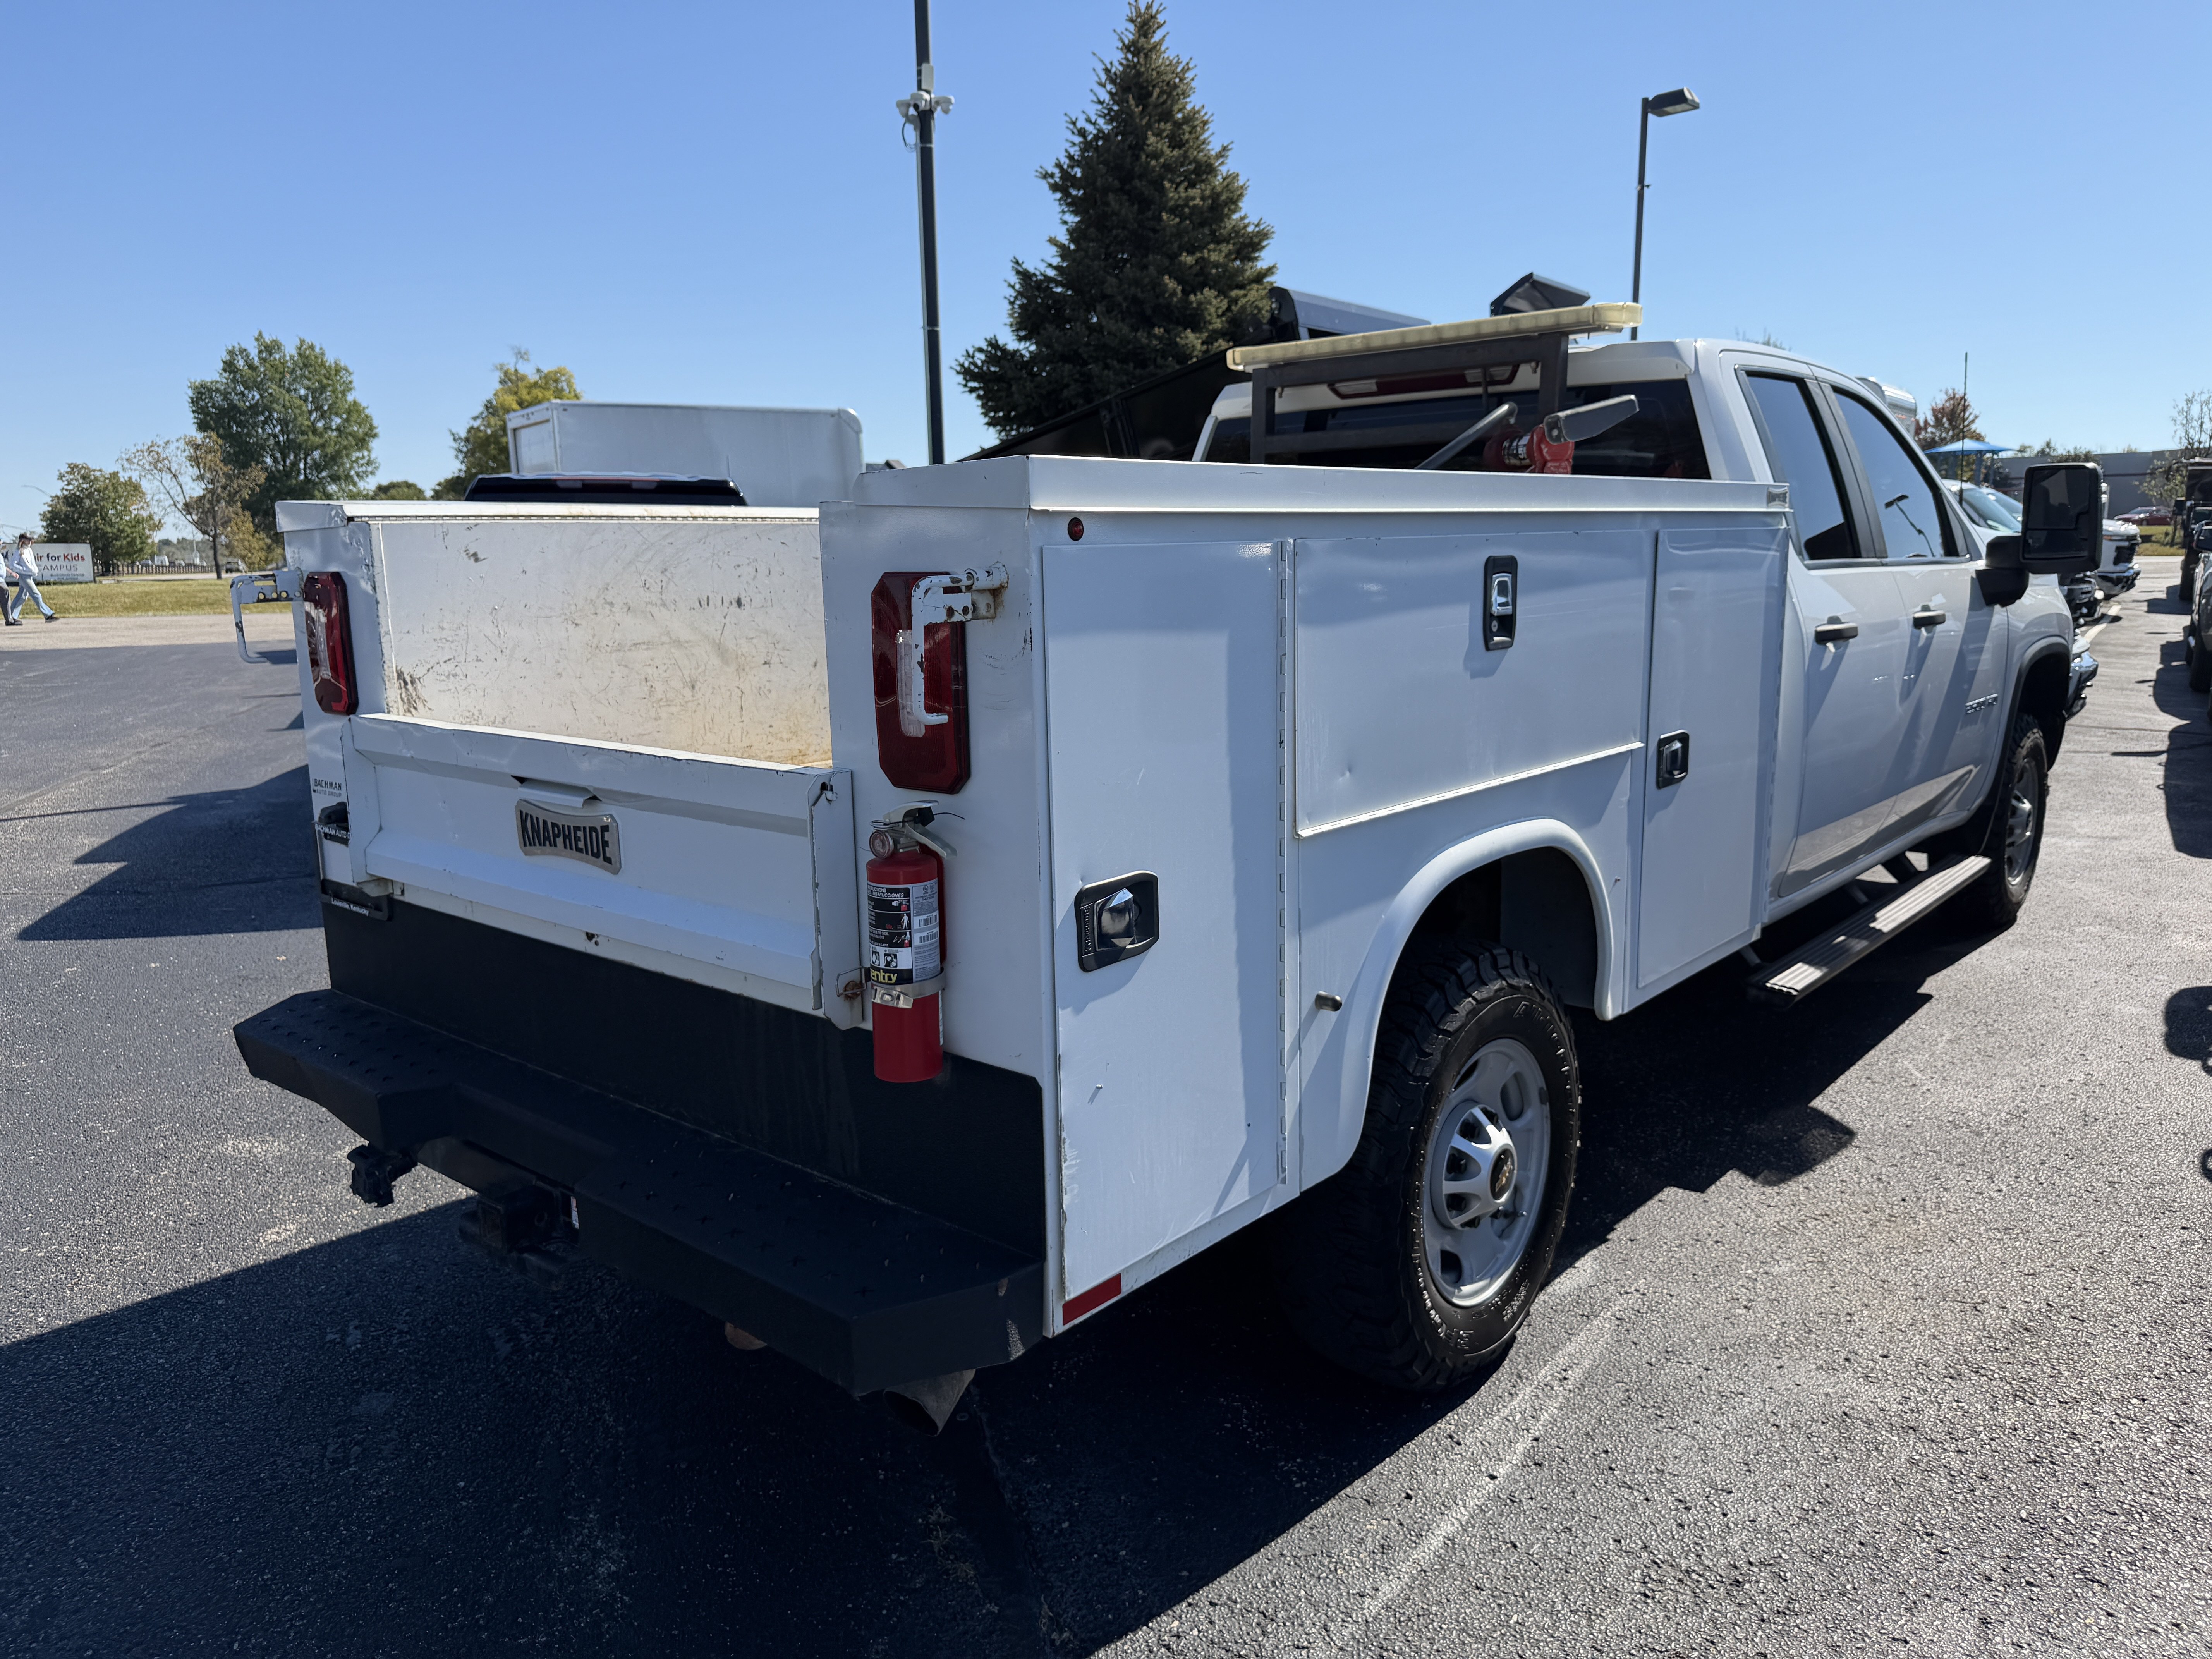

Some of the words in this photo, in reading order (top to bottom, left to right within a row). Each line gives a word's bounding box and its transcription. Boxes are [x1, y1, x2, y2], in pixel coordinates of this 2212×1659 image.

[46, 552, 61, 561] for
[63, 553, 85, 562] Kids
[314, 778, 342, 791] BACHMAN
[519, 809, 613, 866] KNAPHEIDE
[870, 967, 898, 984] entry
